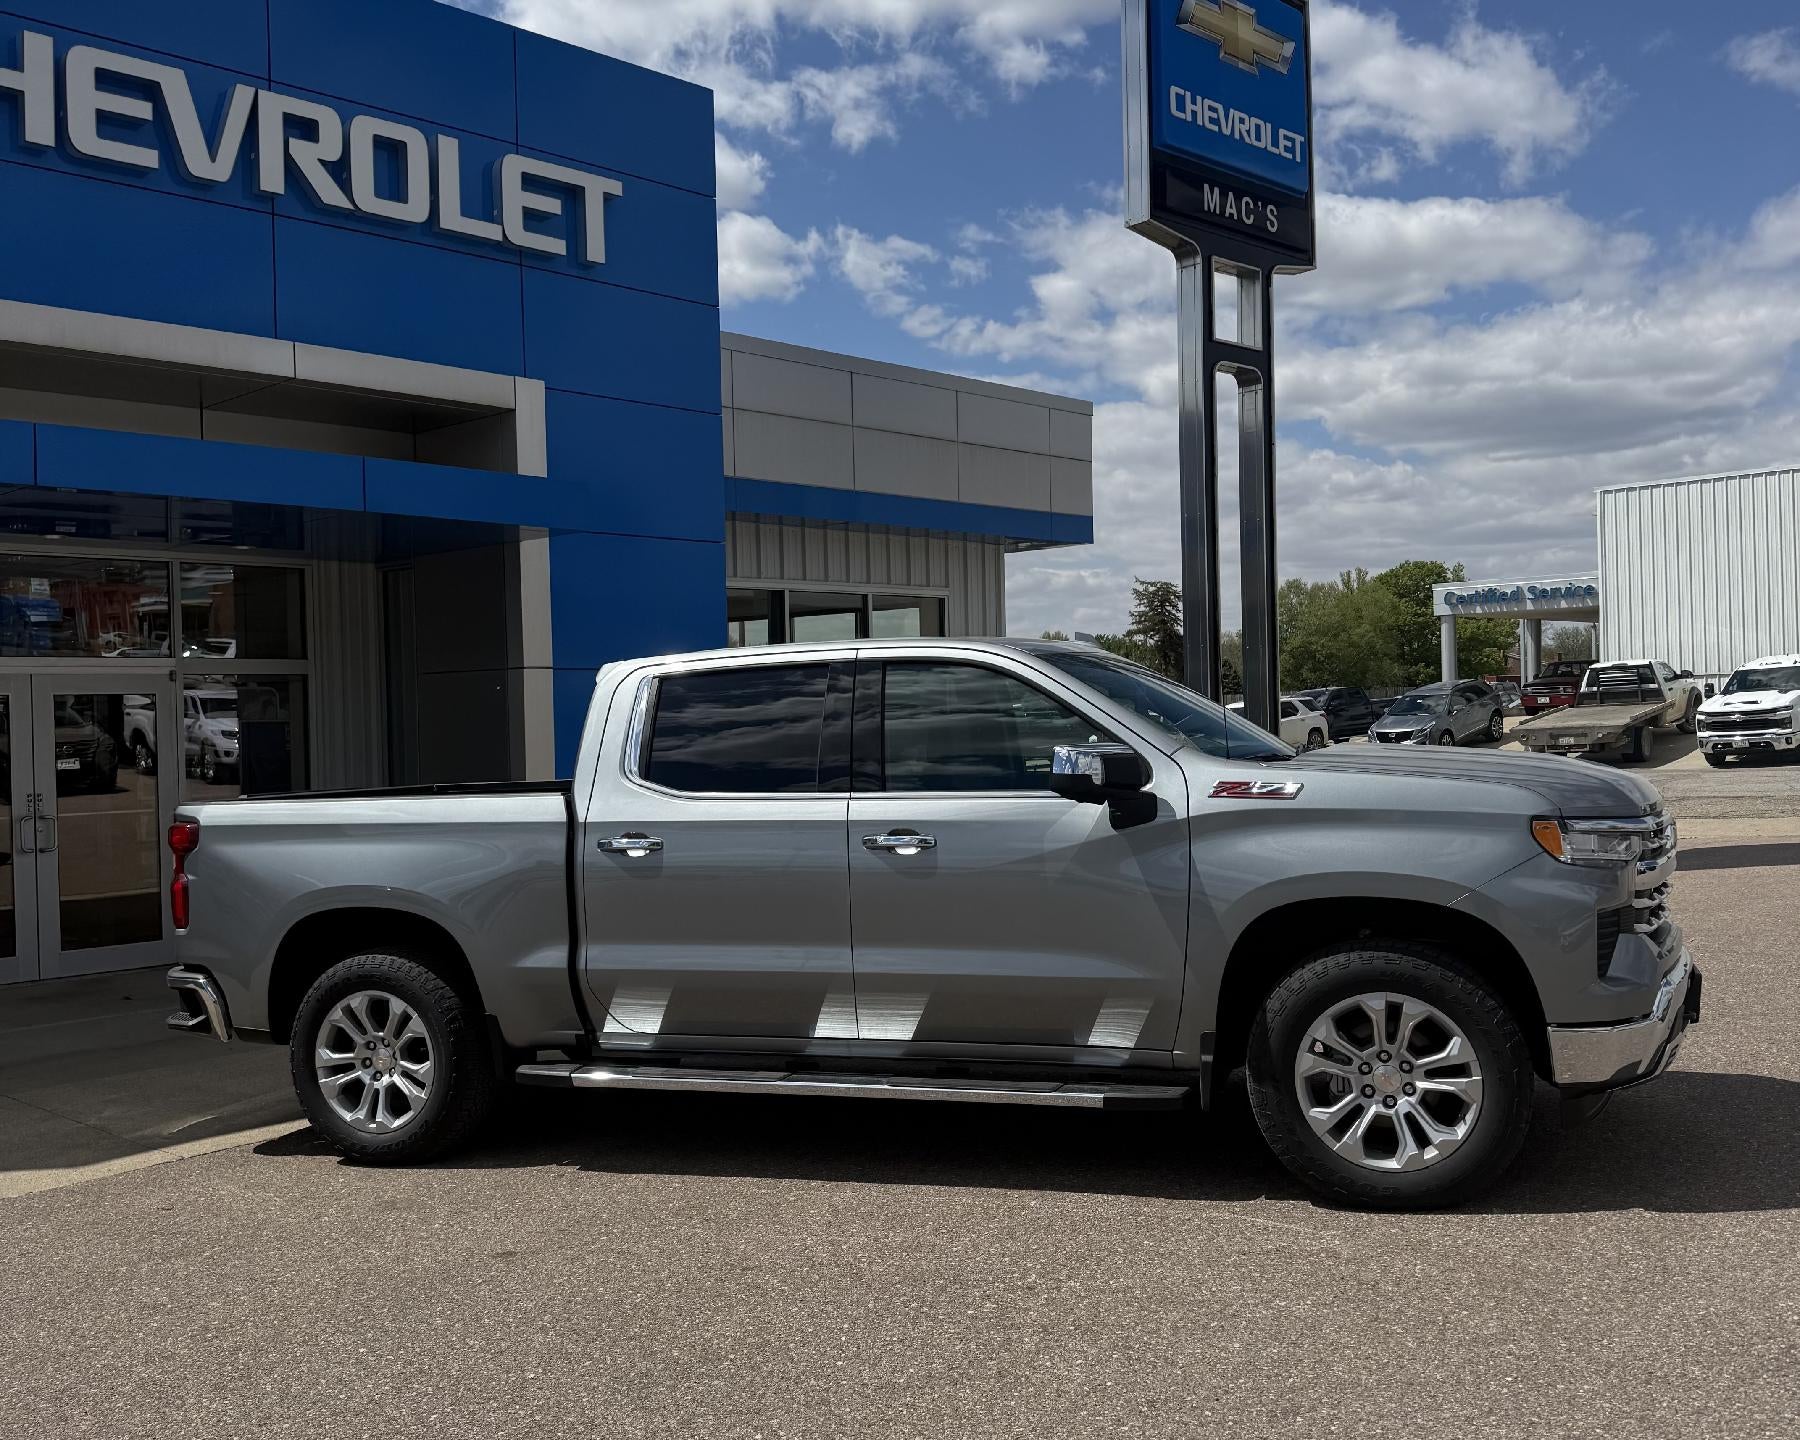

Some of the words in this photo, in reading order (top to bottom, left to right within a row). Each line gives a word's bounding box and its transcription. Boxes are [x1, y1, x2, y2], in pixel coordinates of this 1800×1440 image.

[1169, 85, 1305, 163] CHEVROLET
[1203, 183, 1278, 233] MAC'S
[1444, 585, 1524, 606] Certified
[1527, 582, 1597, 600] Service
